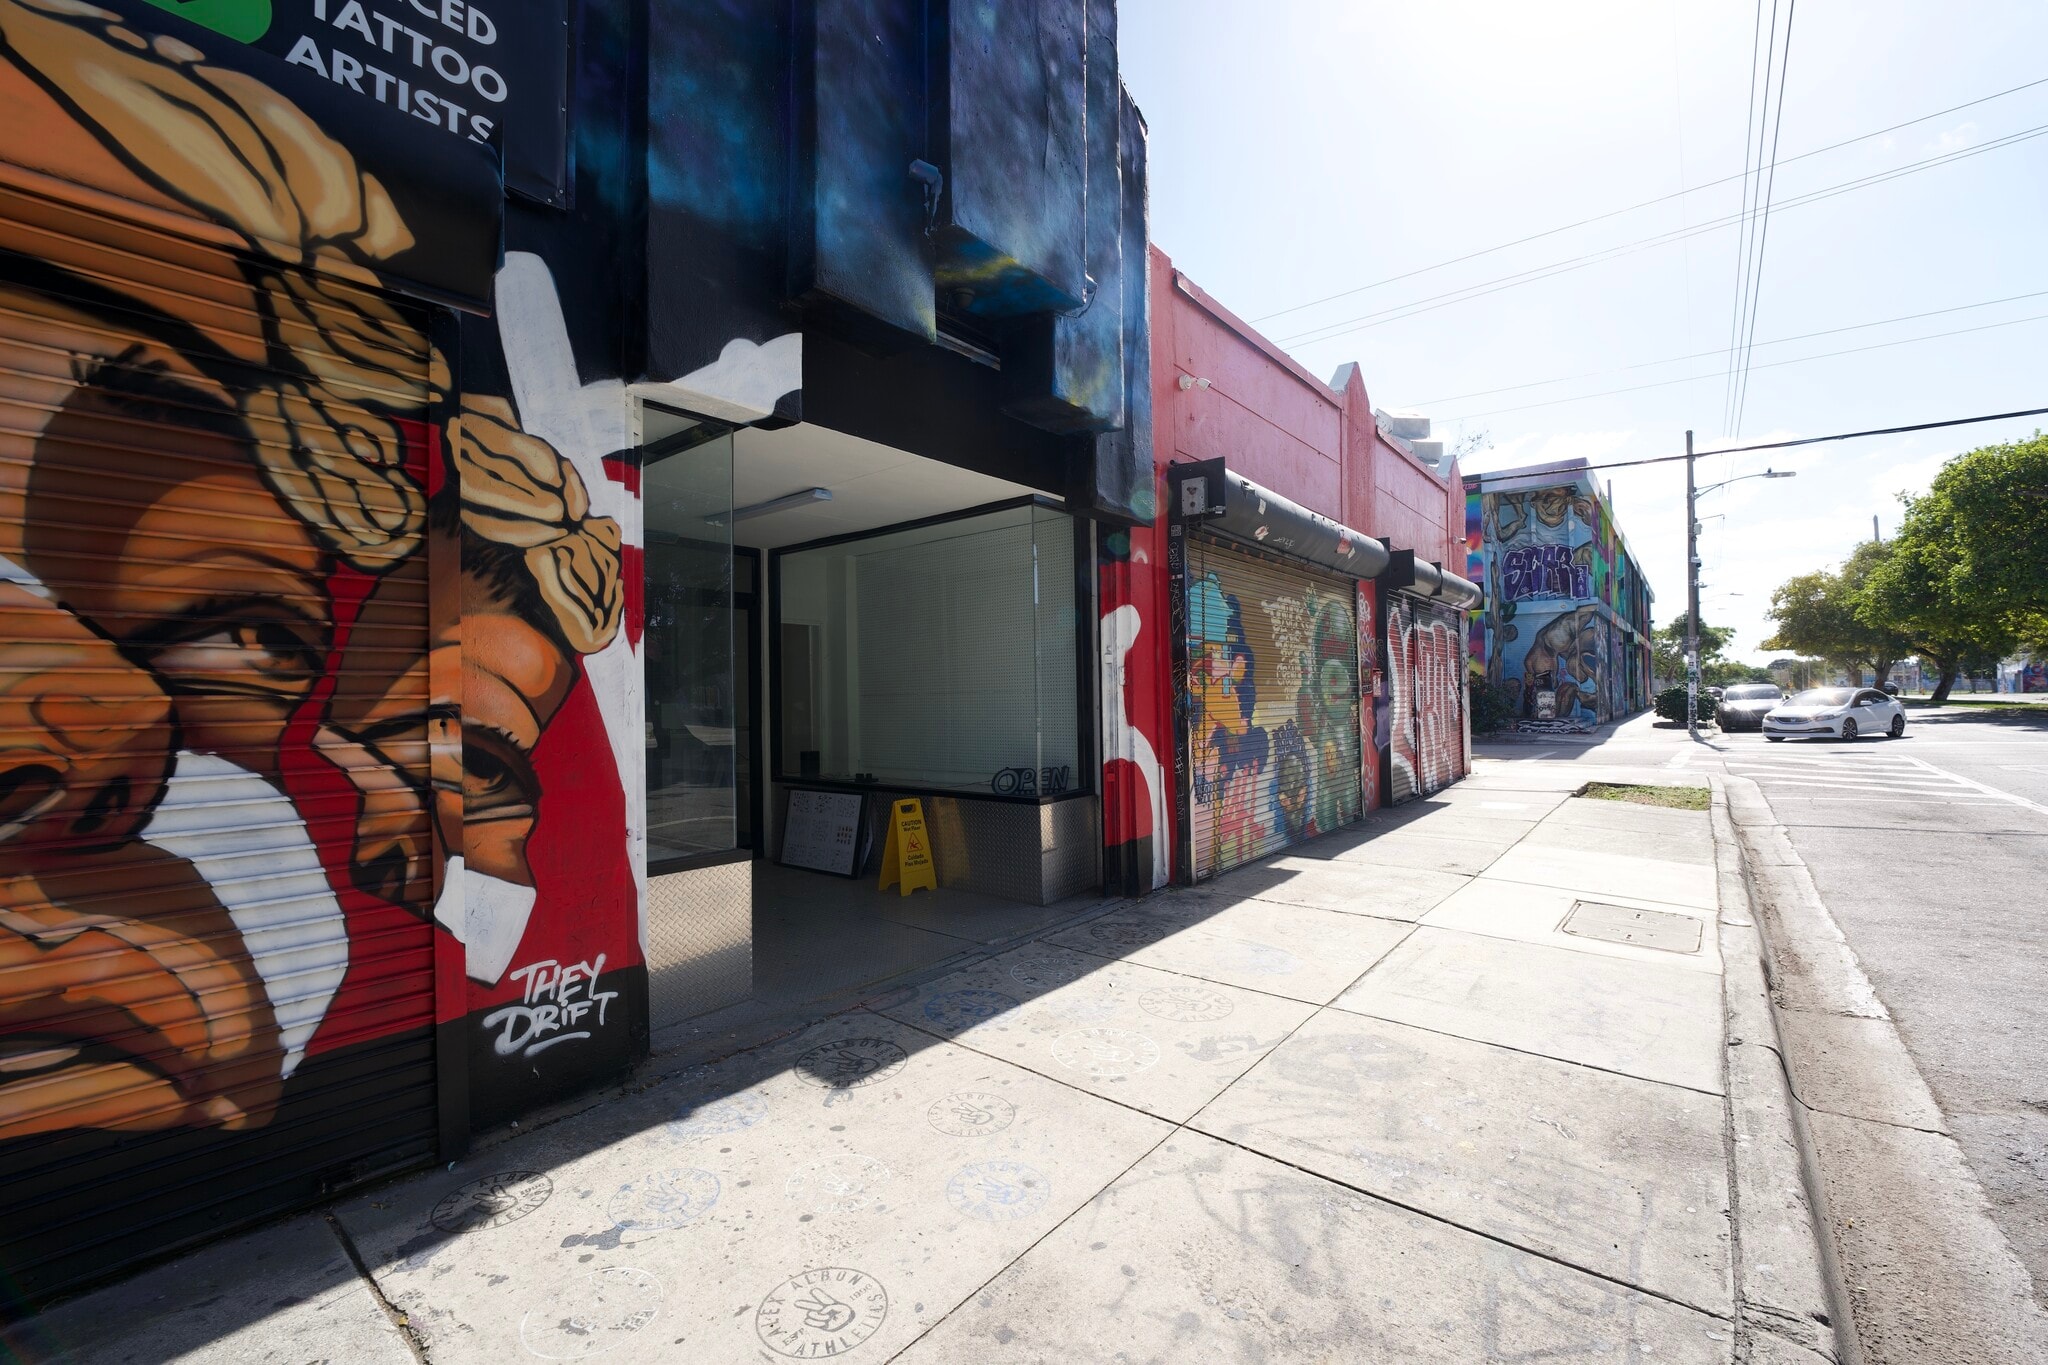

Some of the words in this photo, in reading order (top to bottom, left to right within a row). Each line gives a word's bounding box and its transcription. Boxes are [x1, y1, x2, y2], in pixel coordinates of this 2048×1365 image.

[285, 35, 494, 145] ARTISTS
[993, 766, 1070, 795] OPEN
[510, 953, 606, 1004] THEY
